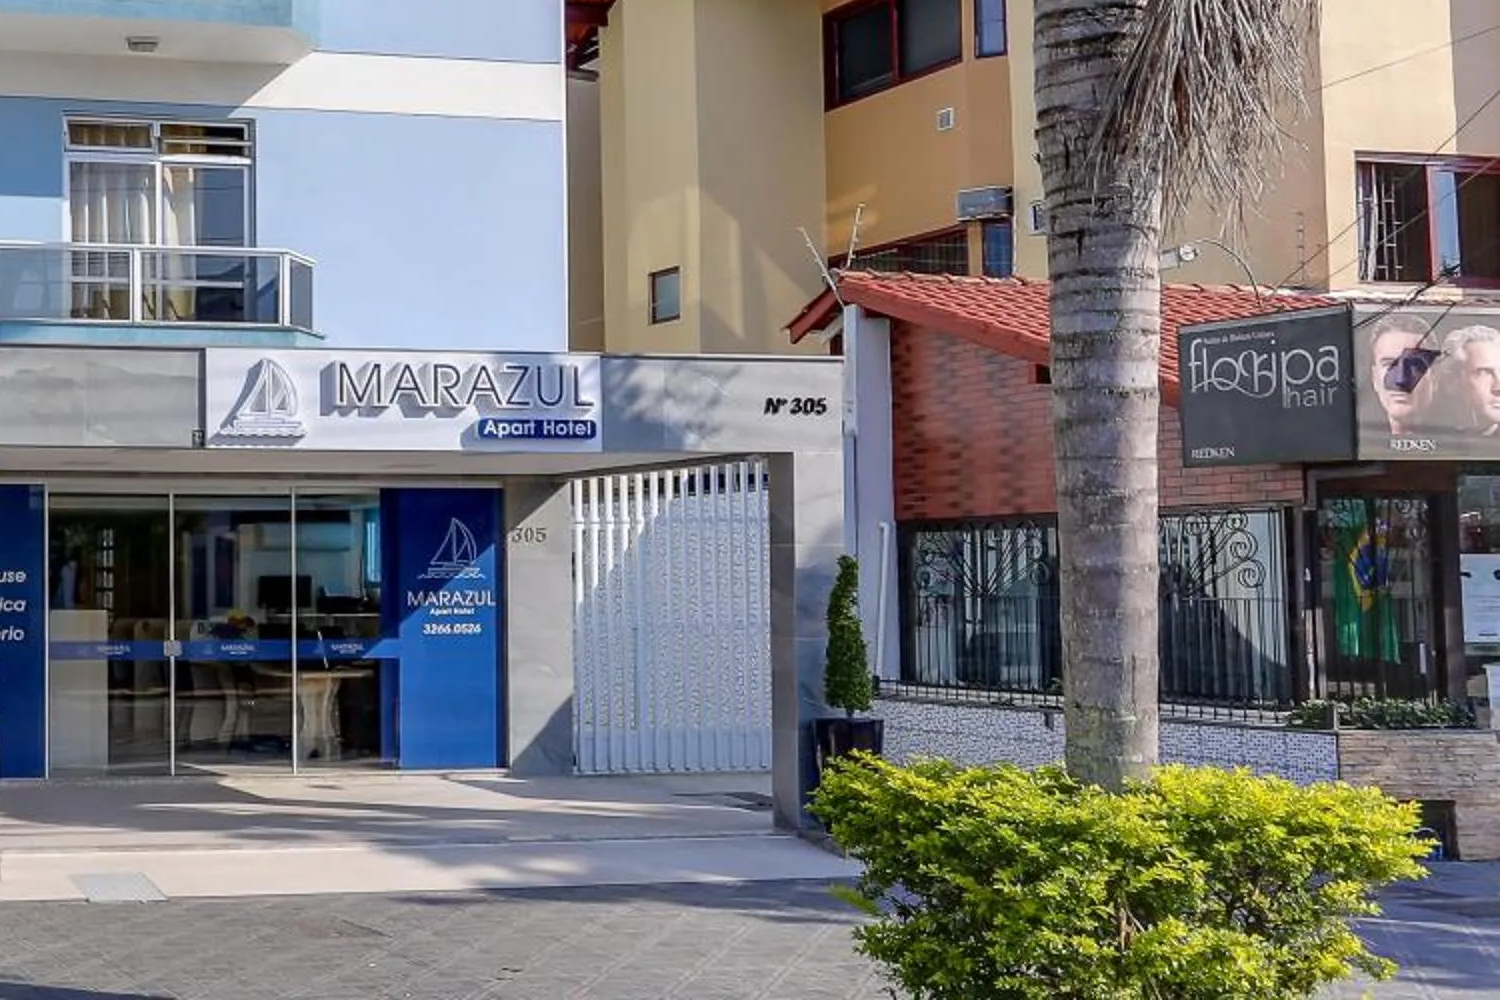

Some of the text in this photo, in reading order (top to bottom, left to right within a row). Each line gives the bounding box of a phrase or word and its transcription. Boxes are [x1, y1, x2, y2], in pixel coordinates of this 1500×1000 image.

[1188, 338, 1339, 408] floripa
[338, 362, 595, 407] MARAZUL
[1286, 383, 1338, 408] hair
[789, 397, 828, 416] 305
[483, 420, 592, 438] Apart Hotel
[511, 527, 547, 543] 305
[407, 590, 497, 607] MARAZUL
